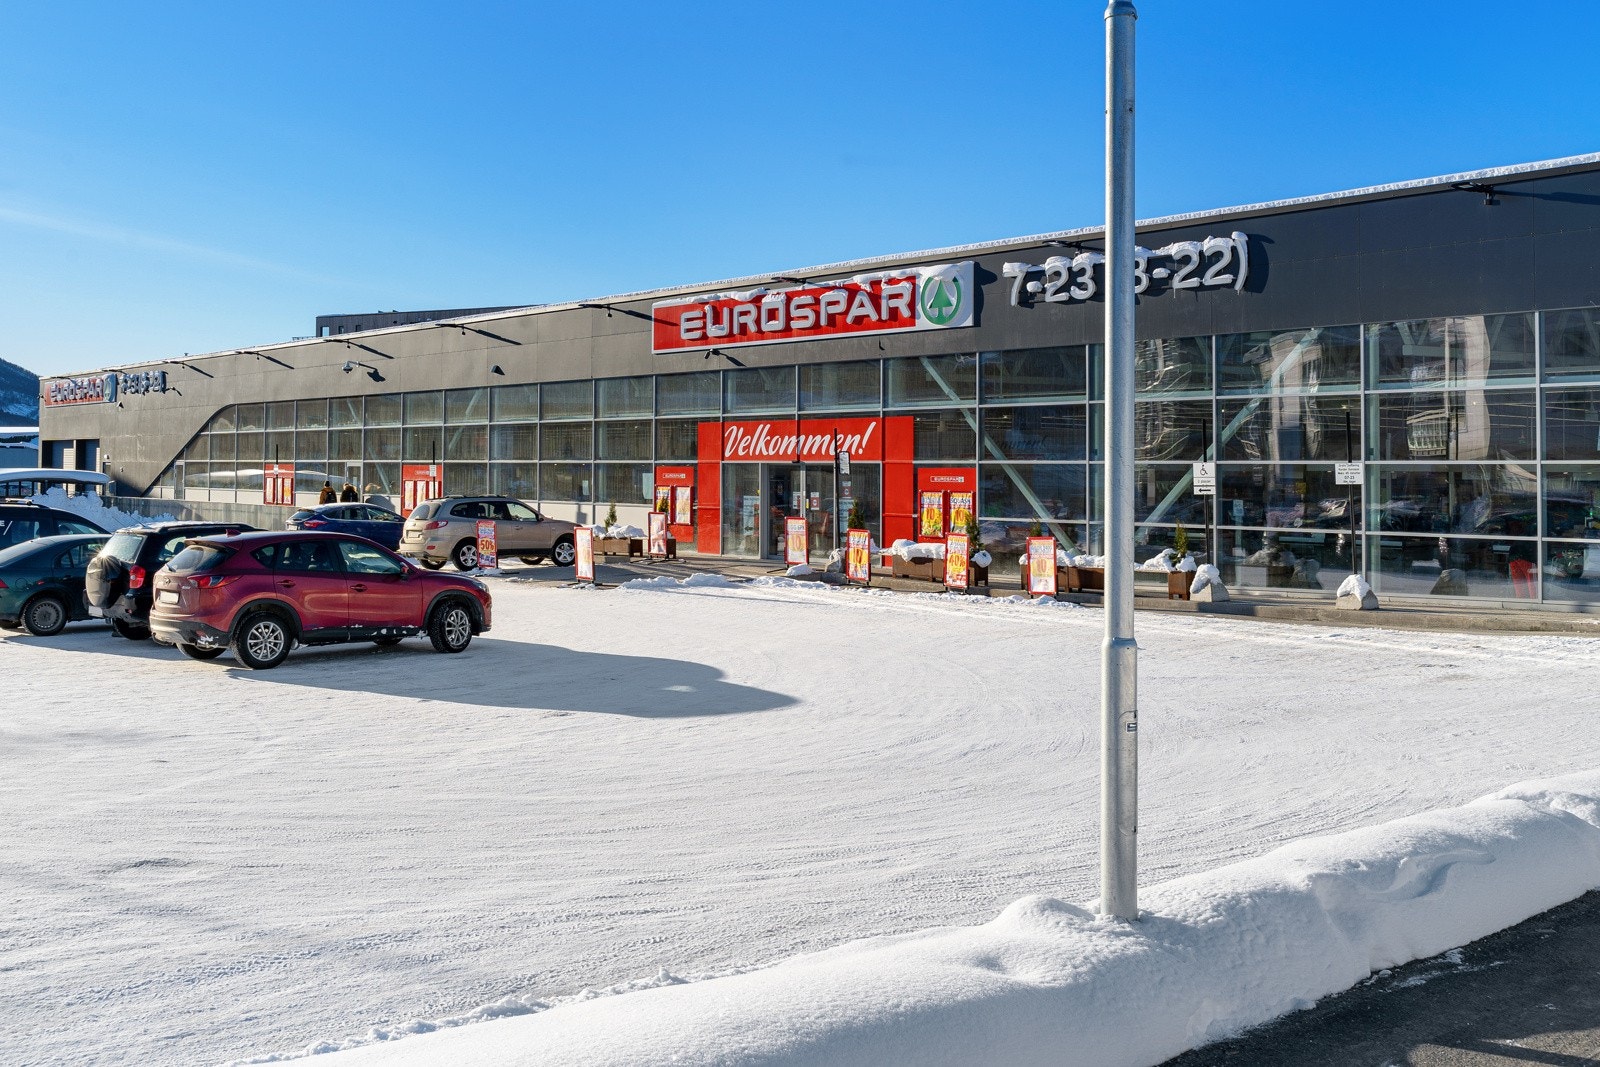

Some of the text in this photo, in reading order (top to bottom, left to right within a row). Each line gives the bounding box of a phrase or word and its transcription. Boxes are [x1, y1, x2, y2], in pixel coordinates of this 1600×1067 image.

[1002, 261, 1098, 306] 7-23
[680, 281, 913, 340] EUROSPAR
[724, 422, 877, 457] Velkommen!
